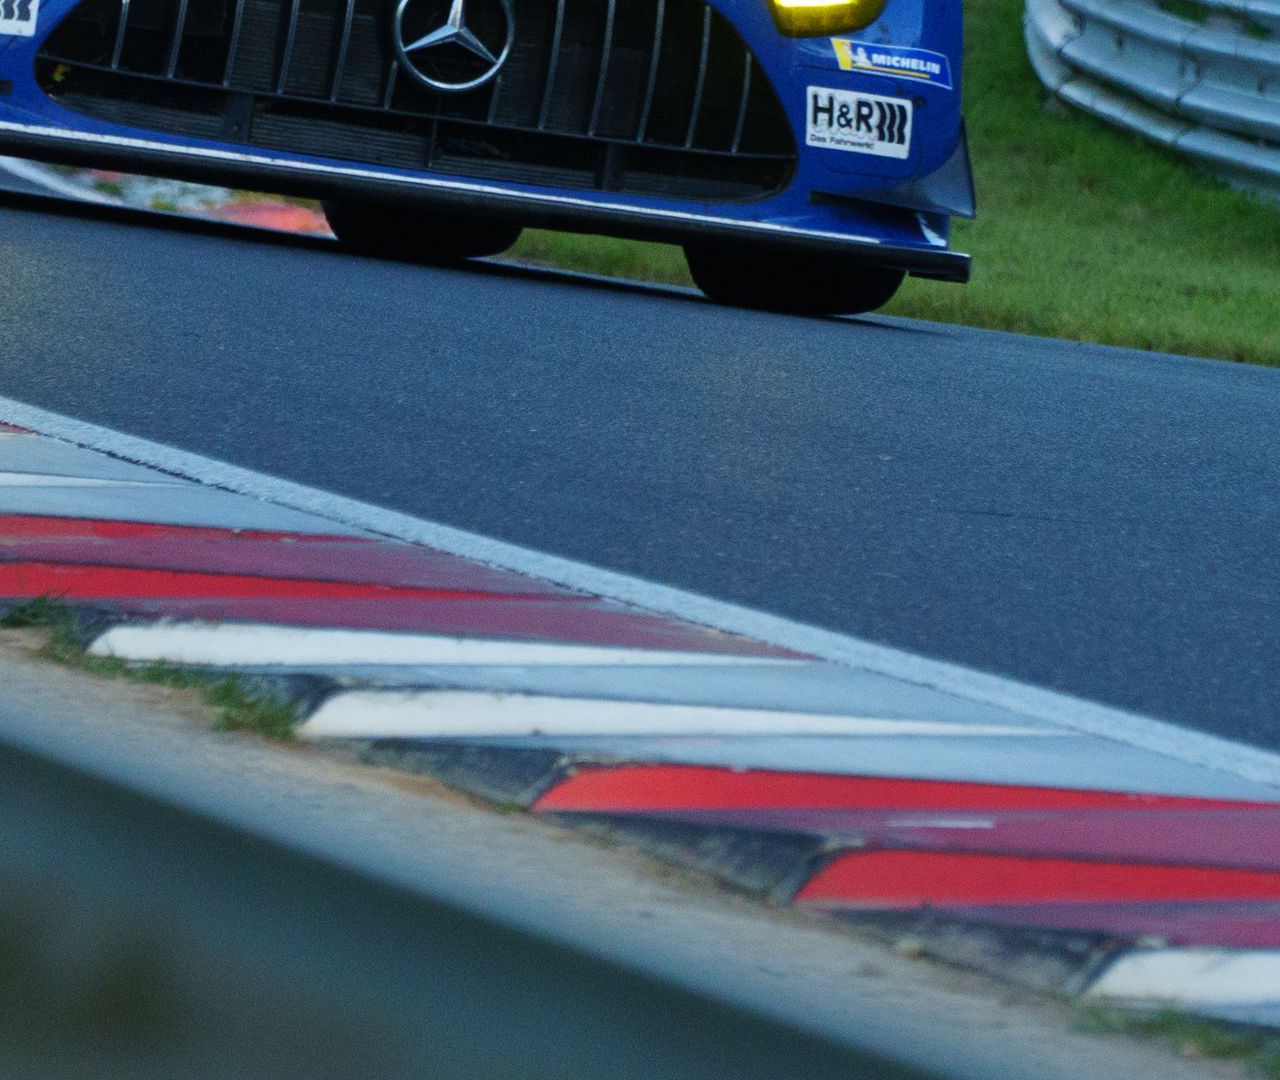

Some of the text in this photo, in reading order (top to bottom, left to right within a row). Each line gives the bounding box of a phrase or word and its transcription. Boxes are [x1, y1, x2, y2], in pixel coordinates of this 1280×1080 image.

[871, 52, 941, 74] MICHELIN
[812, 93, 873, 133] H&R
[810, 133, 827, 144] Das
